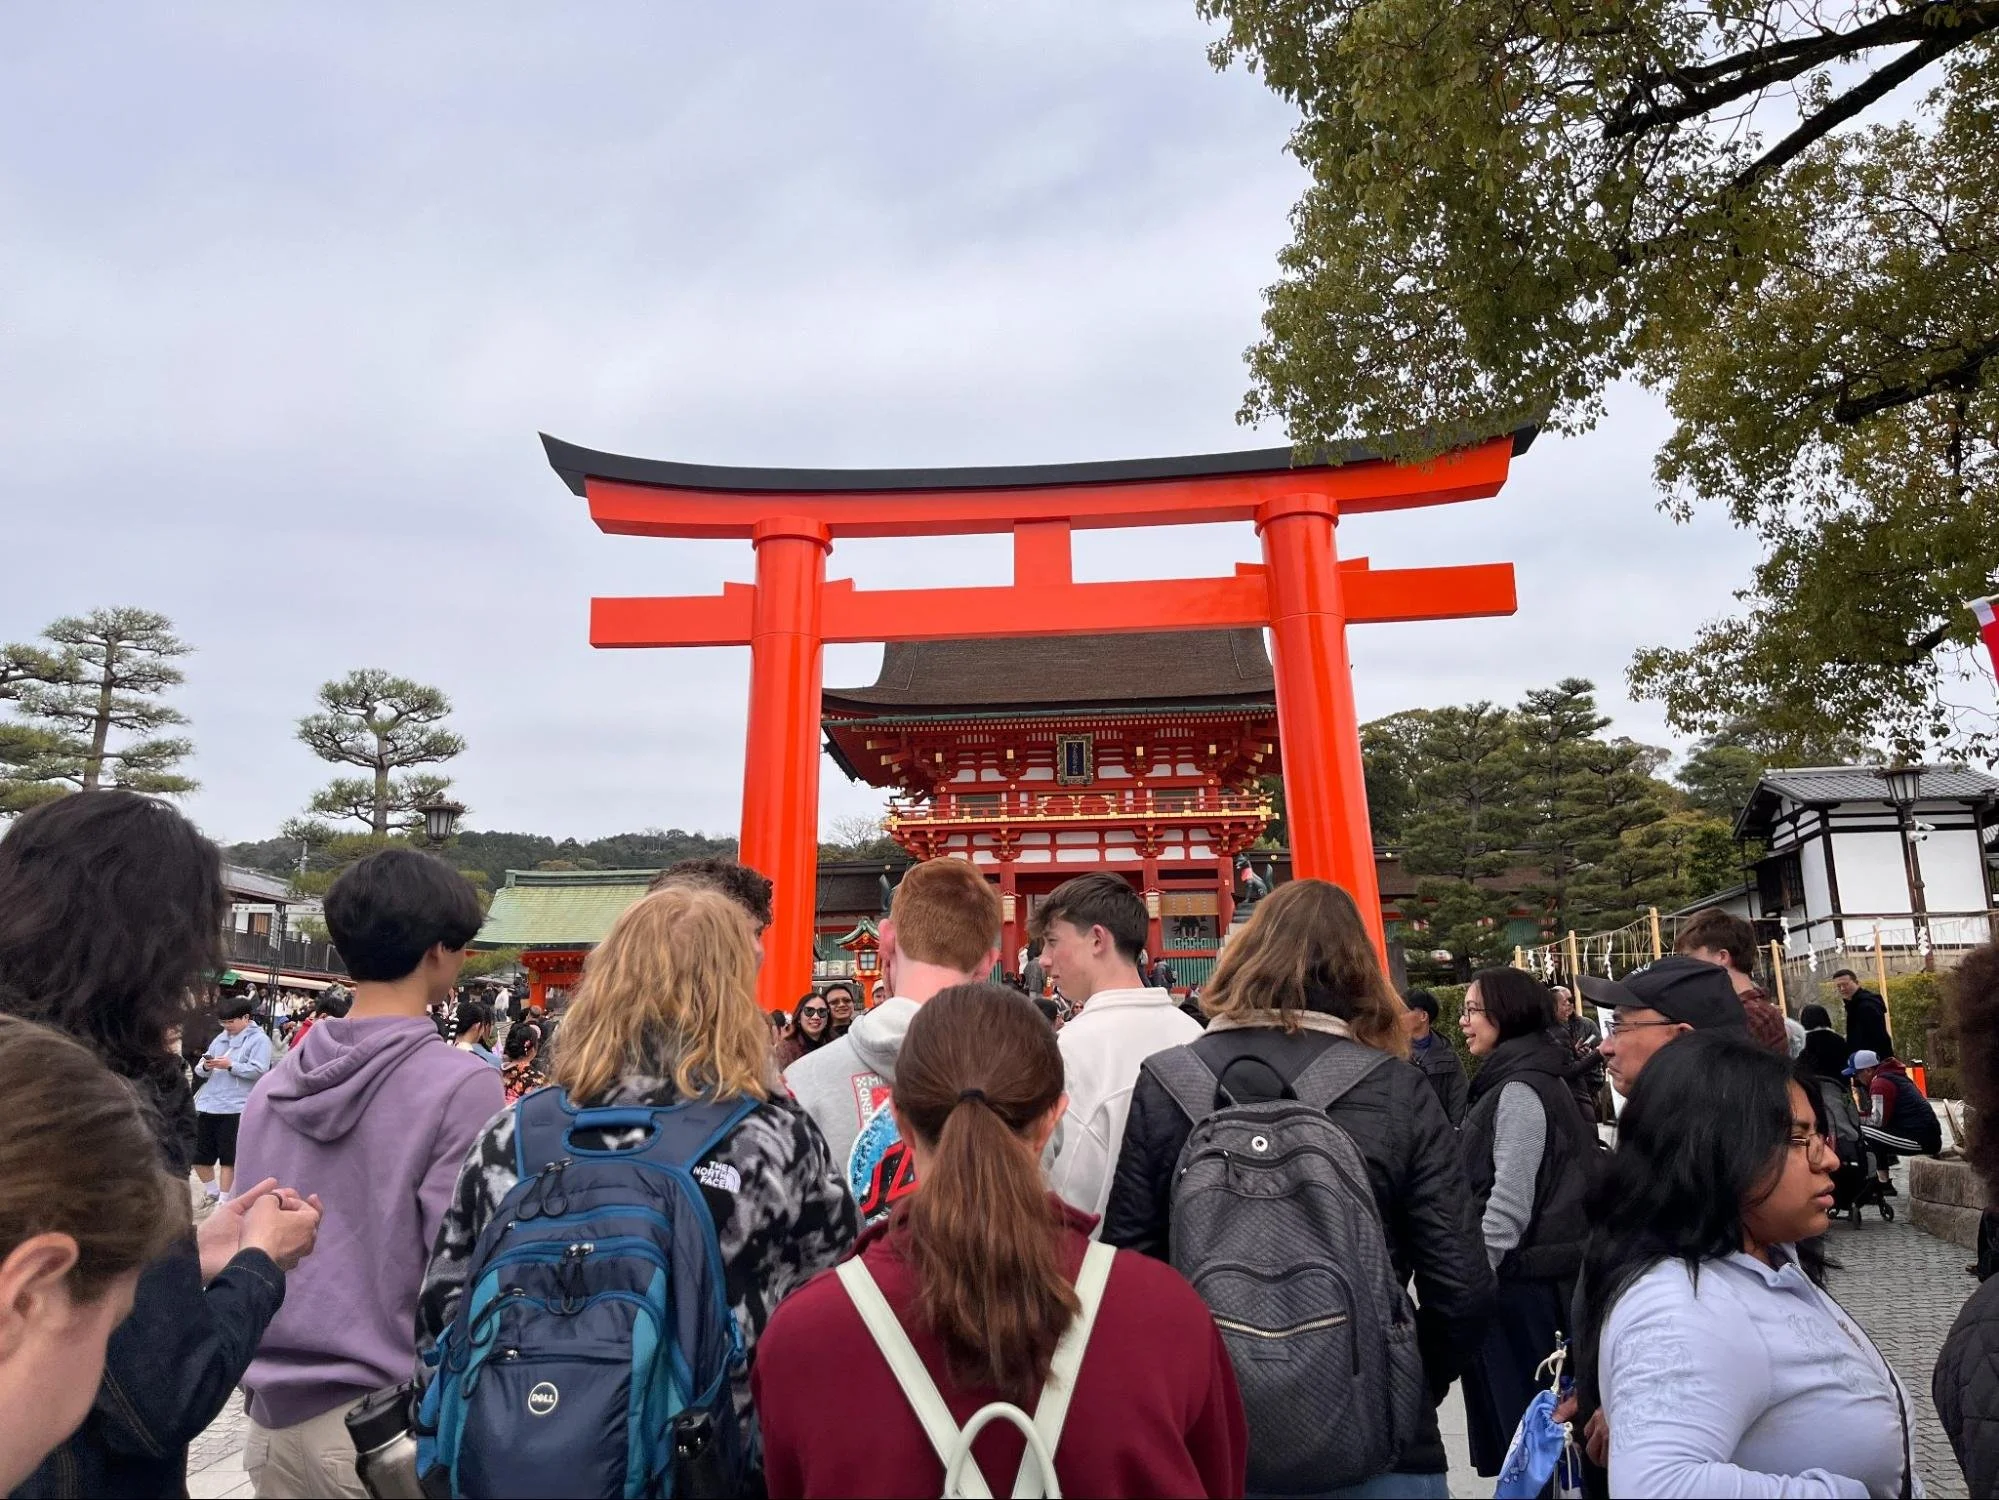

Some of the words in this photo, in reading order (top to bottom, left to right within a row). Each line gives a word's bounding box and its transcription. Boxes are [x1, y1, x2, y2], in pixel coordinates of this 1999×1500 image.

[709, 1161, 728, 1171] THE
[693, 1166, 727, 1180] NORTH
[700, 1176, 728, 1189] FACE
[531, 1393, 554, 1402] DELL
